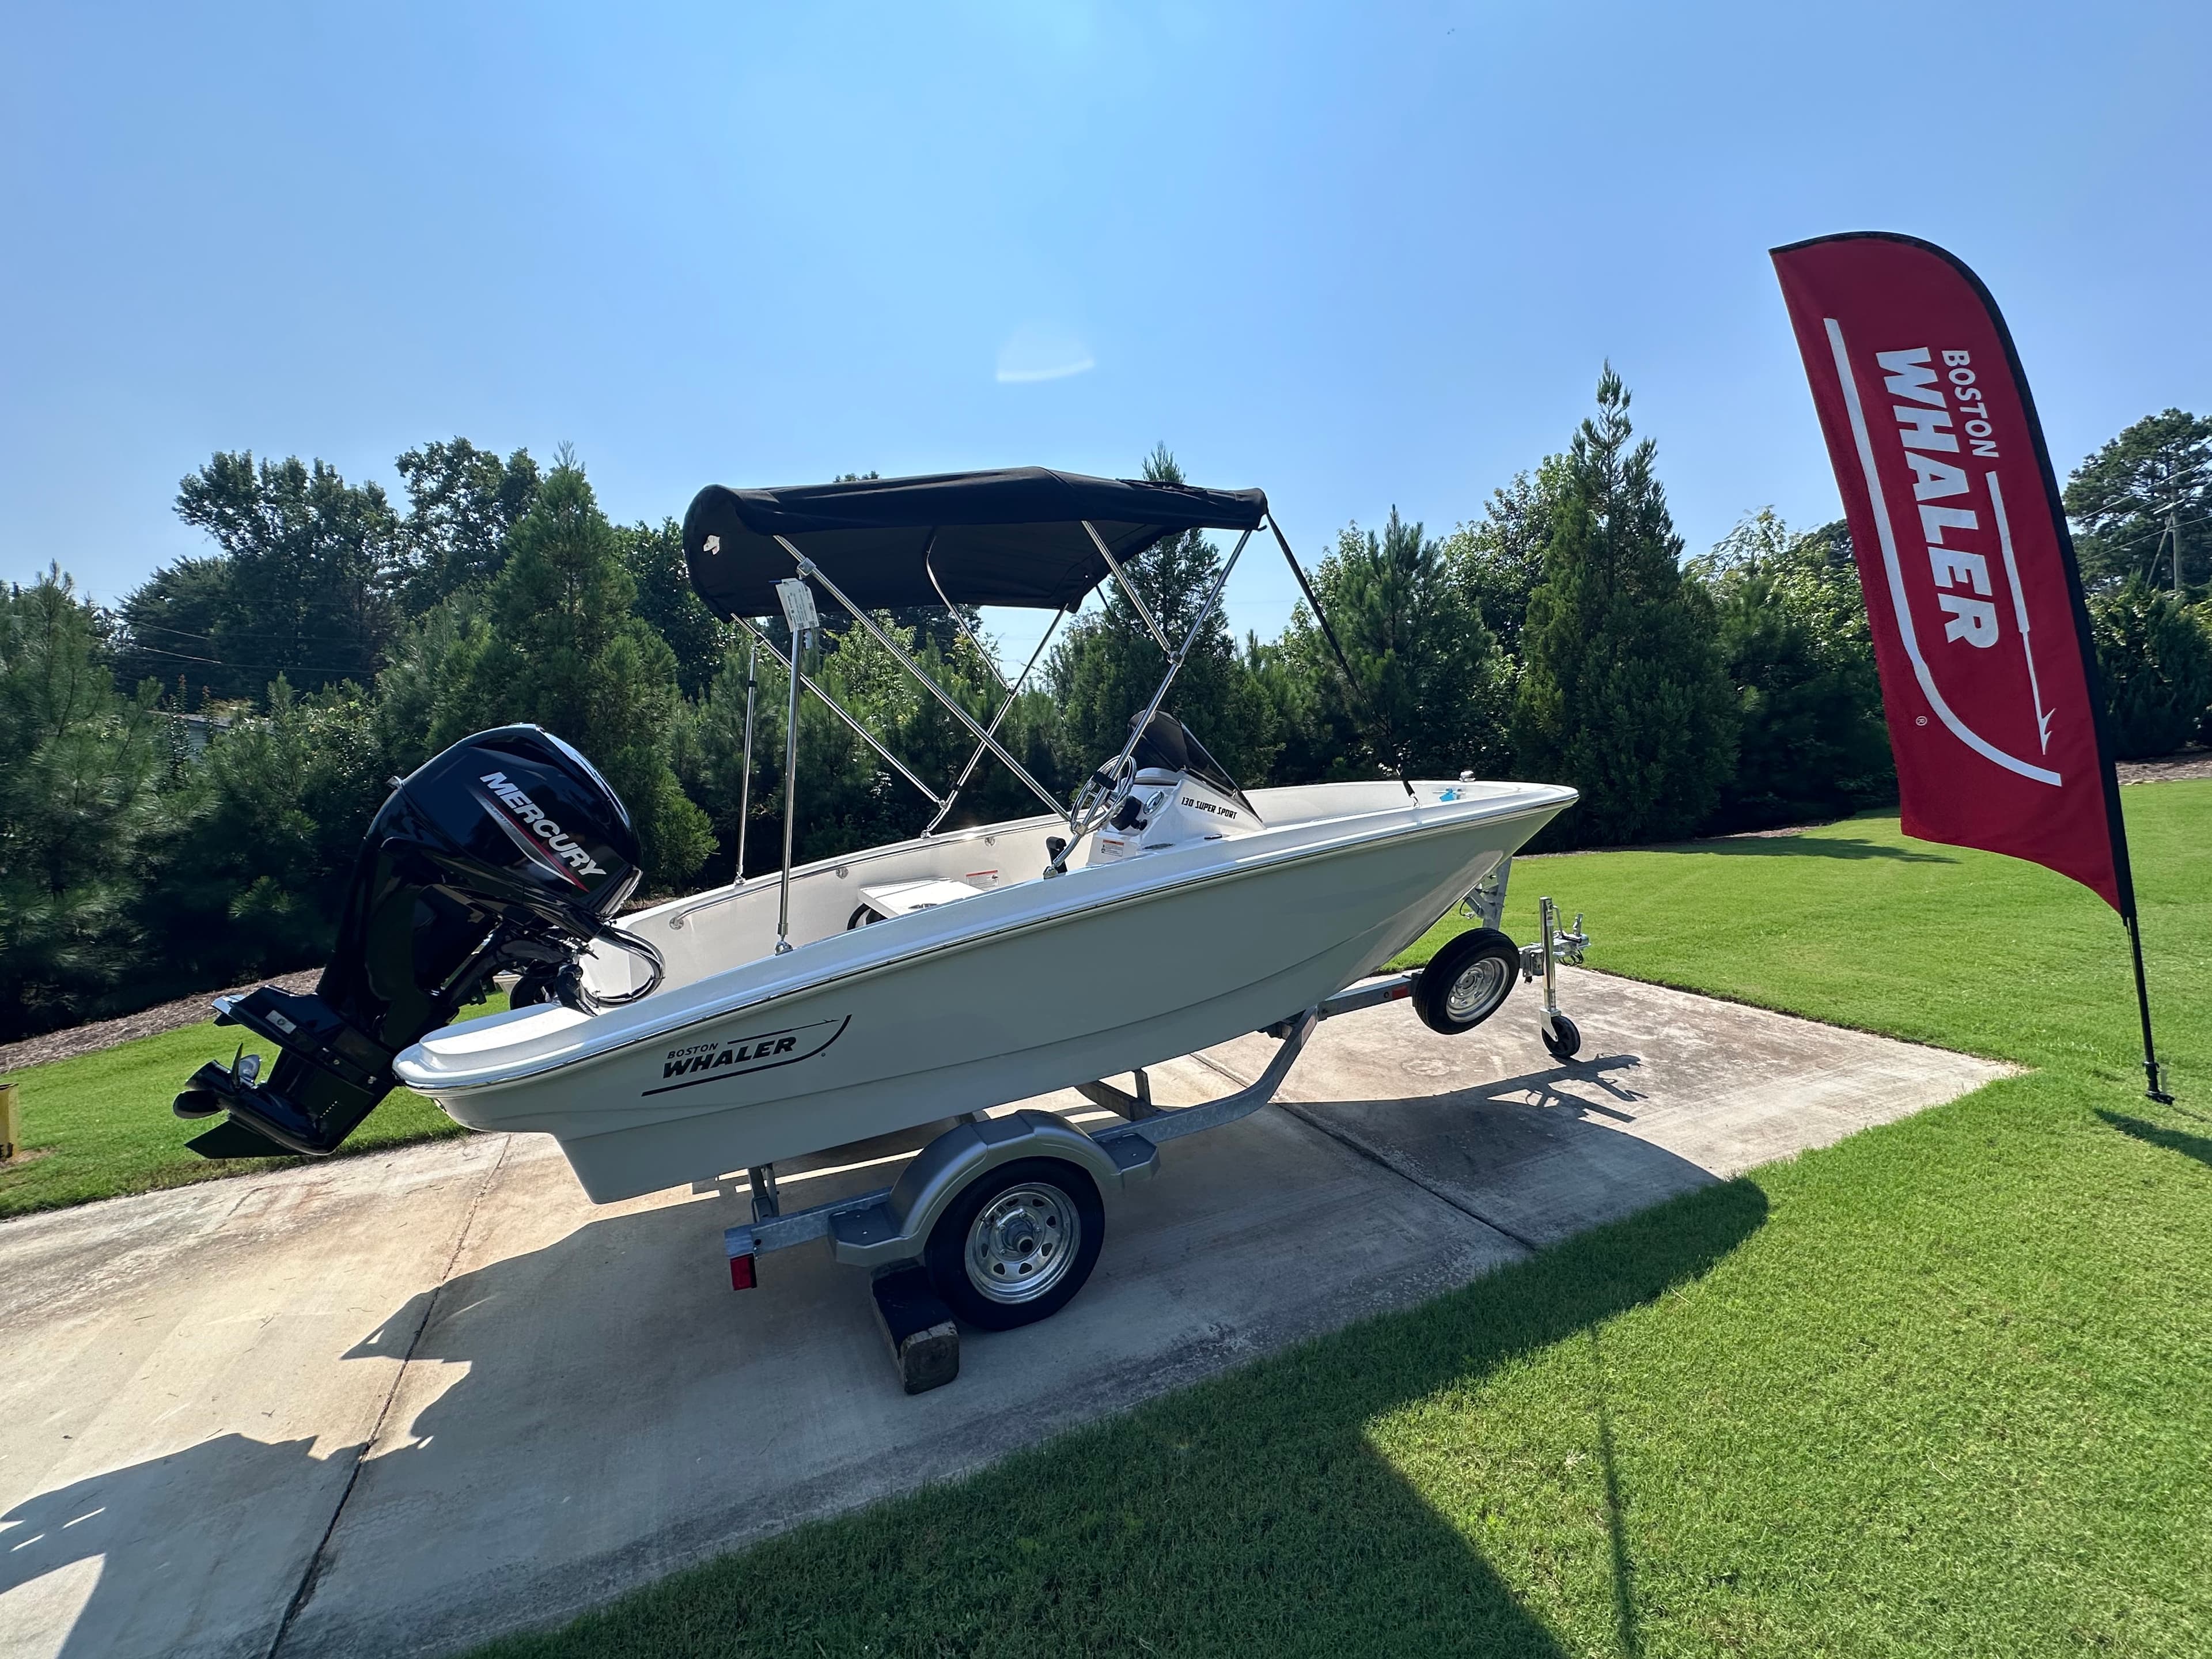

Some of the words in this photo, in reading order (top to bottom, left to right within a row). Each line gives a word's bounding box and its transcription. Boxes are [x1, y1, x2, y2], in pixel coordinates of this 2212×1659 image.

[1941, 350, 1999, 457] BOSTON
[1876, 347, 1999, 649] WHALER
[479, 772, 607, 876] MERCURY
[1181, 797, 1194, 807] 130
[1195, 801, 1217, 813] SUPER
[1217, 807, 1237, 819] SPORT
[663, 1037, 796, 1078] WHALER
[667, 1043, 718, 1059] BOSTON
